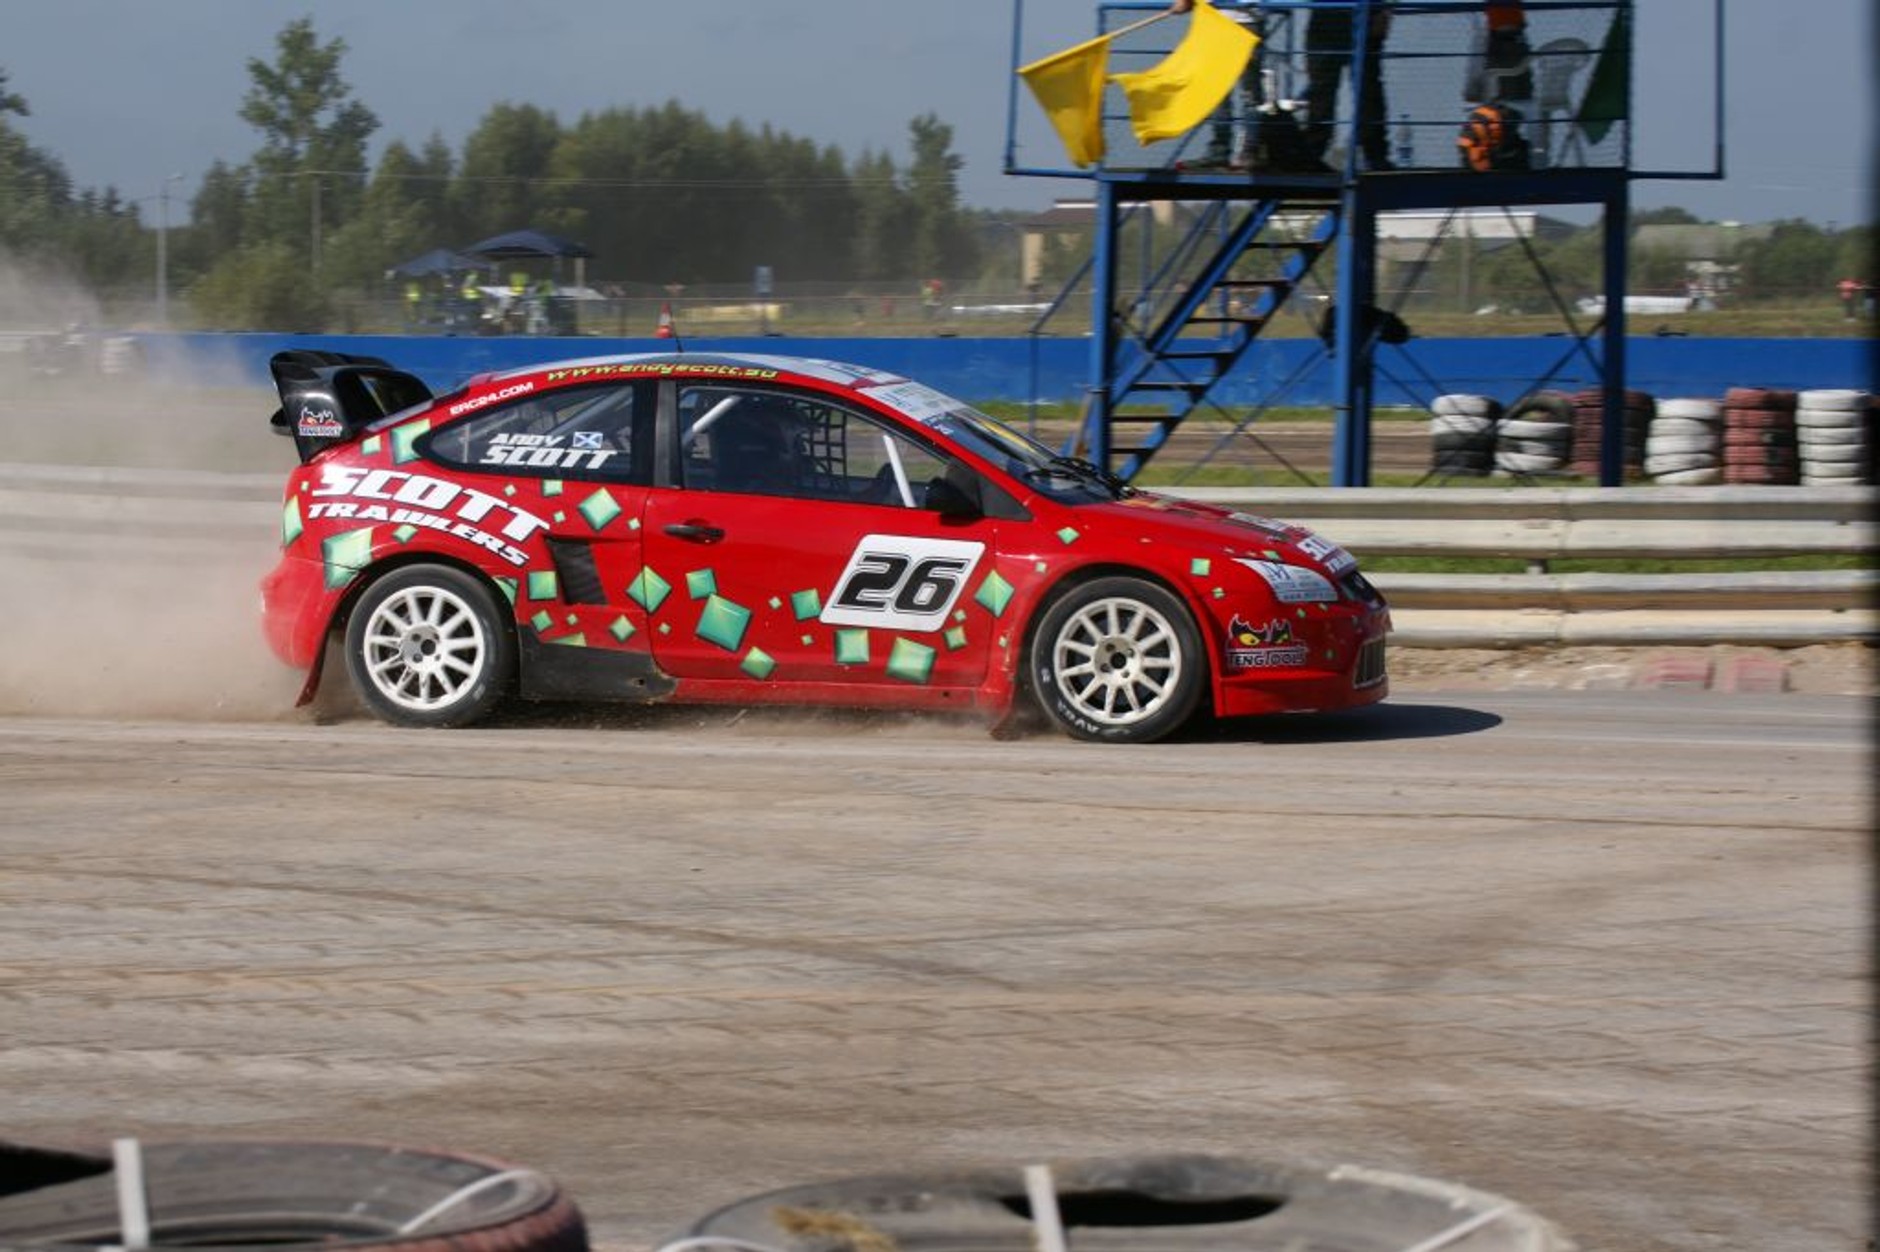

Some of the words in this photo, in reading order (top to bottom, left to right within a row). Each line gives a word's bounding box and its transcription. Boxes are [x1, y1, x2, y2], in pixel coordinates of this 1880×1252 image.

[479, 445, 618, 469] SCOTT
[308, 502, 530, 566] TRAWLERS
[312, 463, 551, 543] SCOTT
[831, 551, 972, 615] 26
